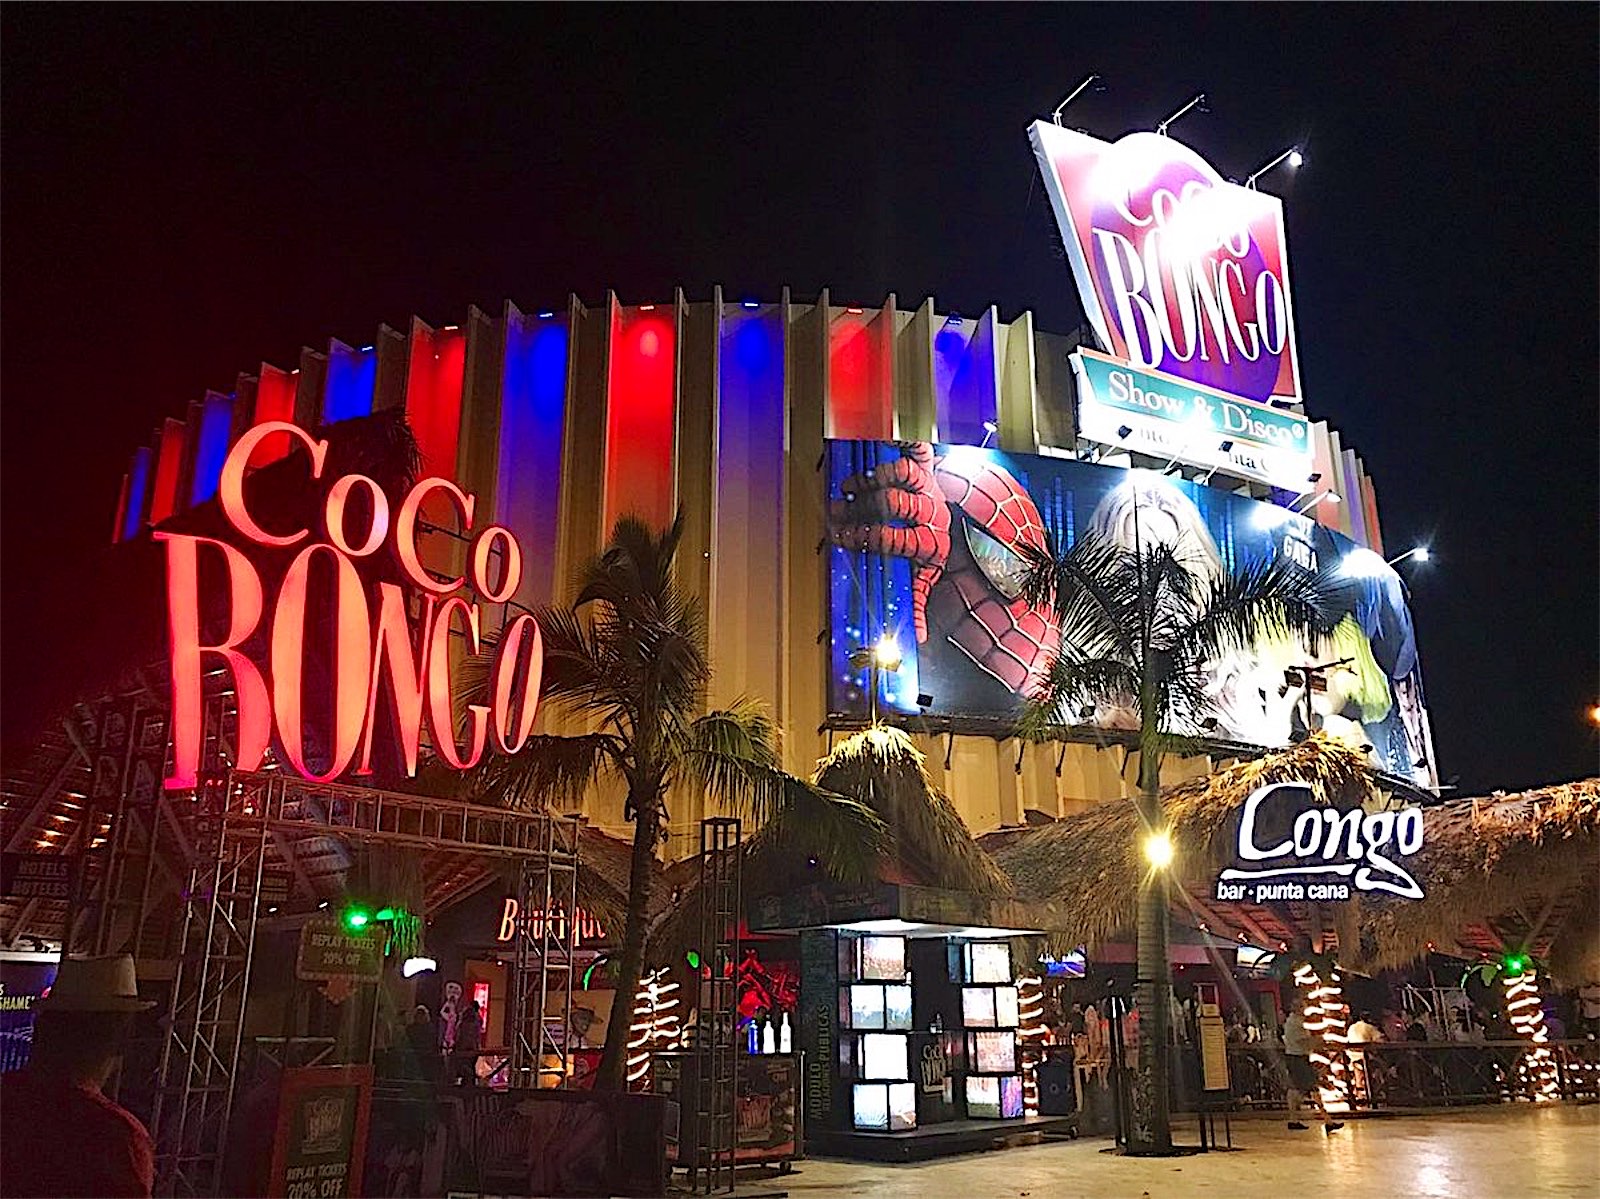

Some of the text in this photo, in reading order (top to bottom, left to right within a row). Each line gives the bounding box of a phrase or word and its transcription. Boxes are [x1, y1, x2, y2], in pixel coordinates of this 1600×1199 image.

[1092, 226, 1287, 369] BONGO
[1108, 371, 1186, 417] Show
[1283, 535, 1318, 573] GAGA
[153, 531, 543, 790] BONGO
[1239, 782, 1425, 899] Congo
[1217, 882, 1349, 903] bar punta cana
[321, 1177, 344, 1198] OFF
